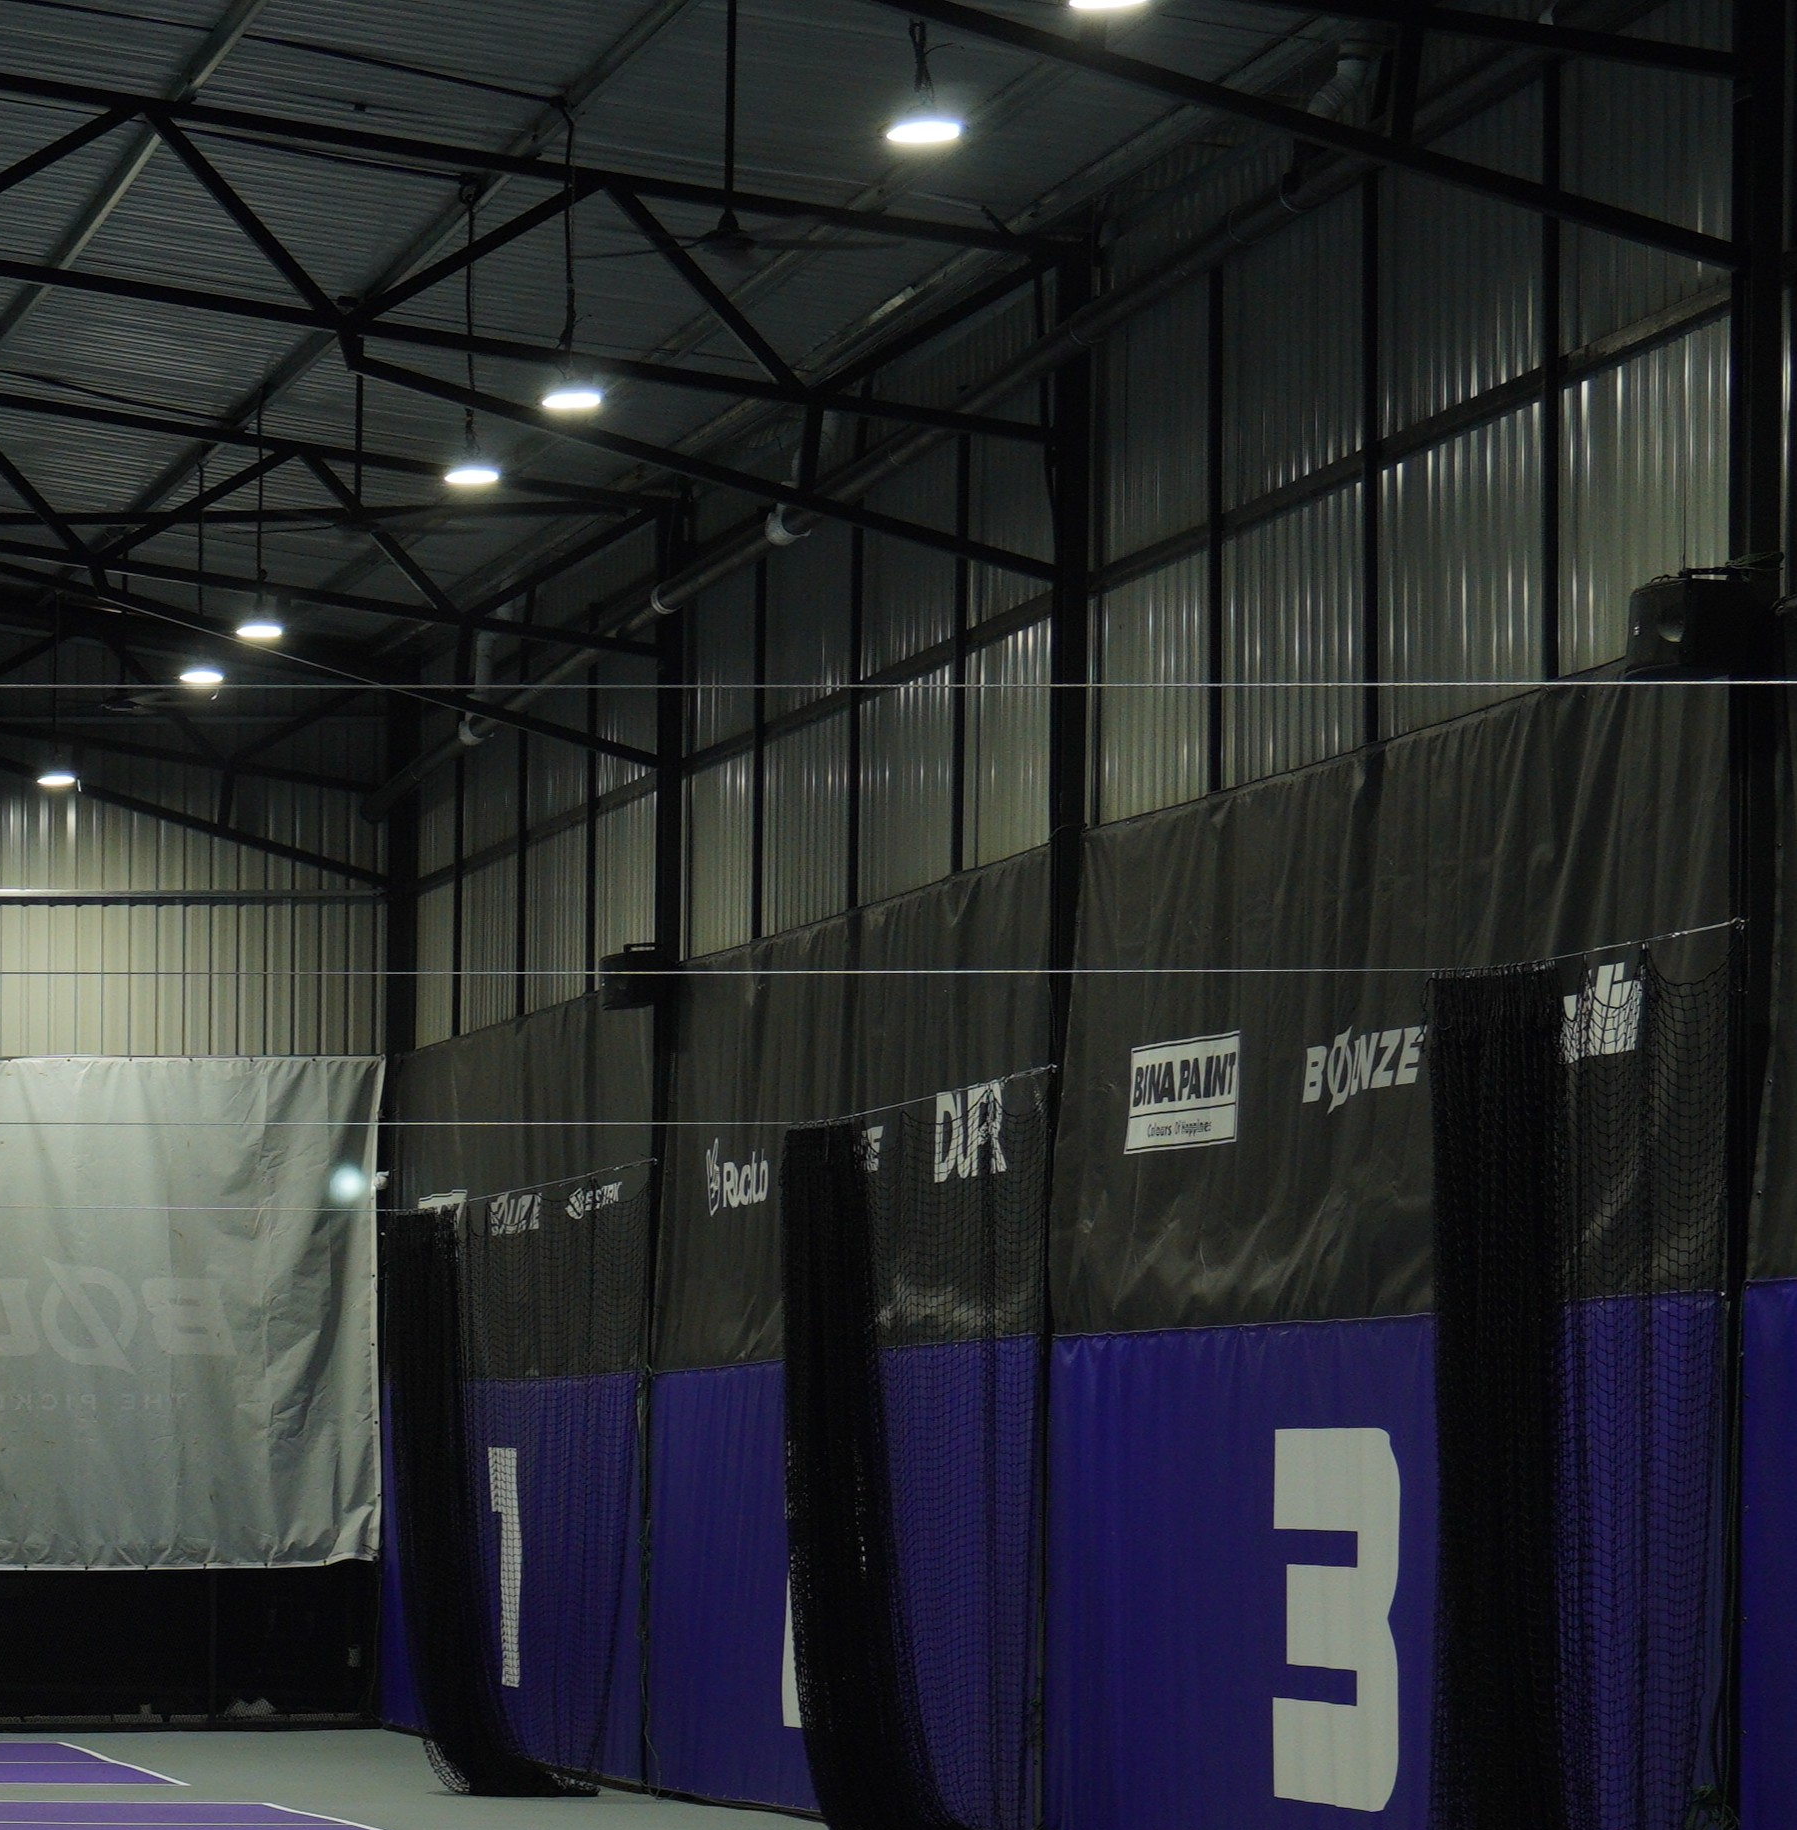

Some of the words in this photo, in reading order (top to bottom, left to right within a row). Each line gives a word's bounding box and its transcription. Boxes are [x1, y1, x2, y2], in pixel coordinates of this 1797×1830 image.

[1132, 1059, 1175, 1108] BINA
[1177, 1051, 1237, 1101] PAINT
[1147, 1122, 1172, 1138] Colours
[488, 1446, 522, 1688] 1
[1272, 1427, 1401, 1812] 3
